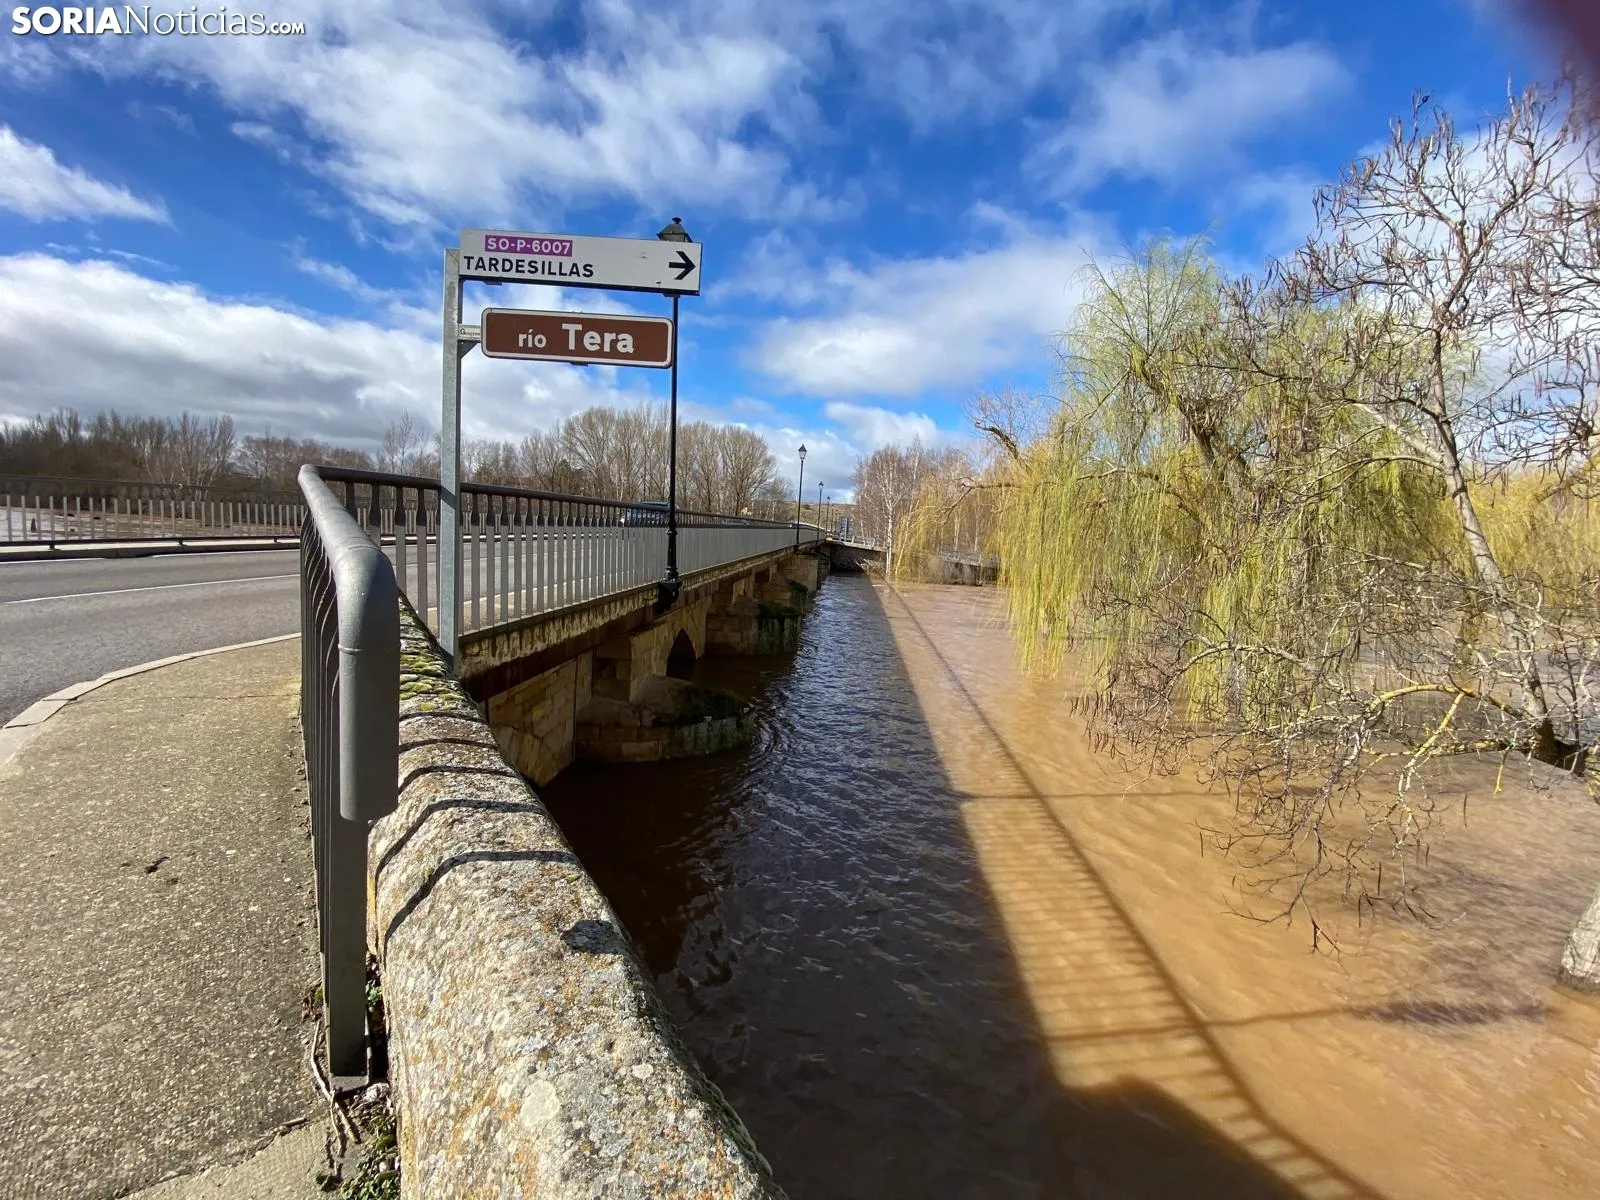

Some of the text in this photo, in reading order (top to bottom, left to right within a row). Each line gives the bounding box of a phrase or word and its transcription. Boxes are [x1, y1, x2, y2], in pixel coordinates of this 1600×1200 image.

[487, 237, 571, 254] SO-P-6007
[463, 255, 594, 278] TARDESILLAS
[518, 323, 635, 354] río Tera
